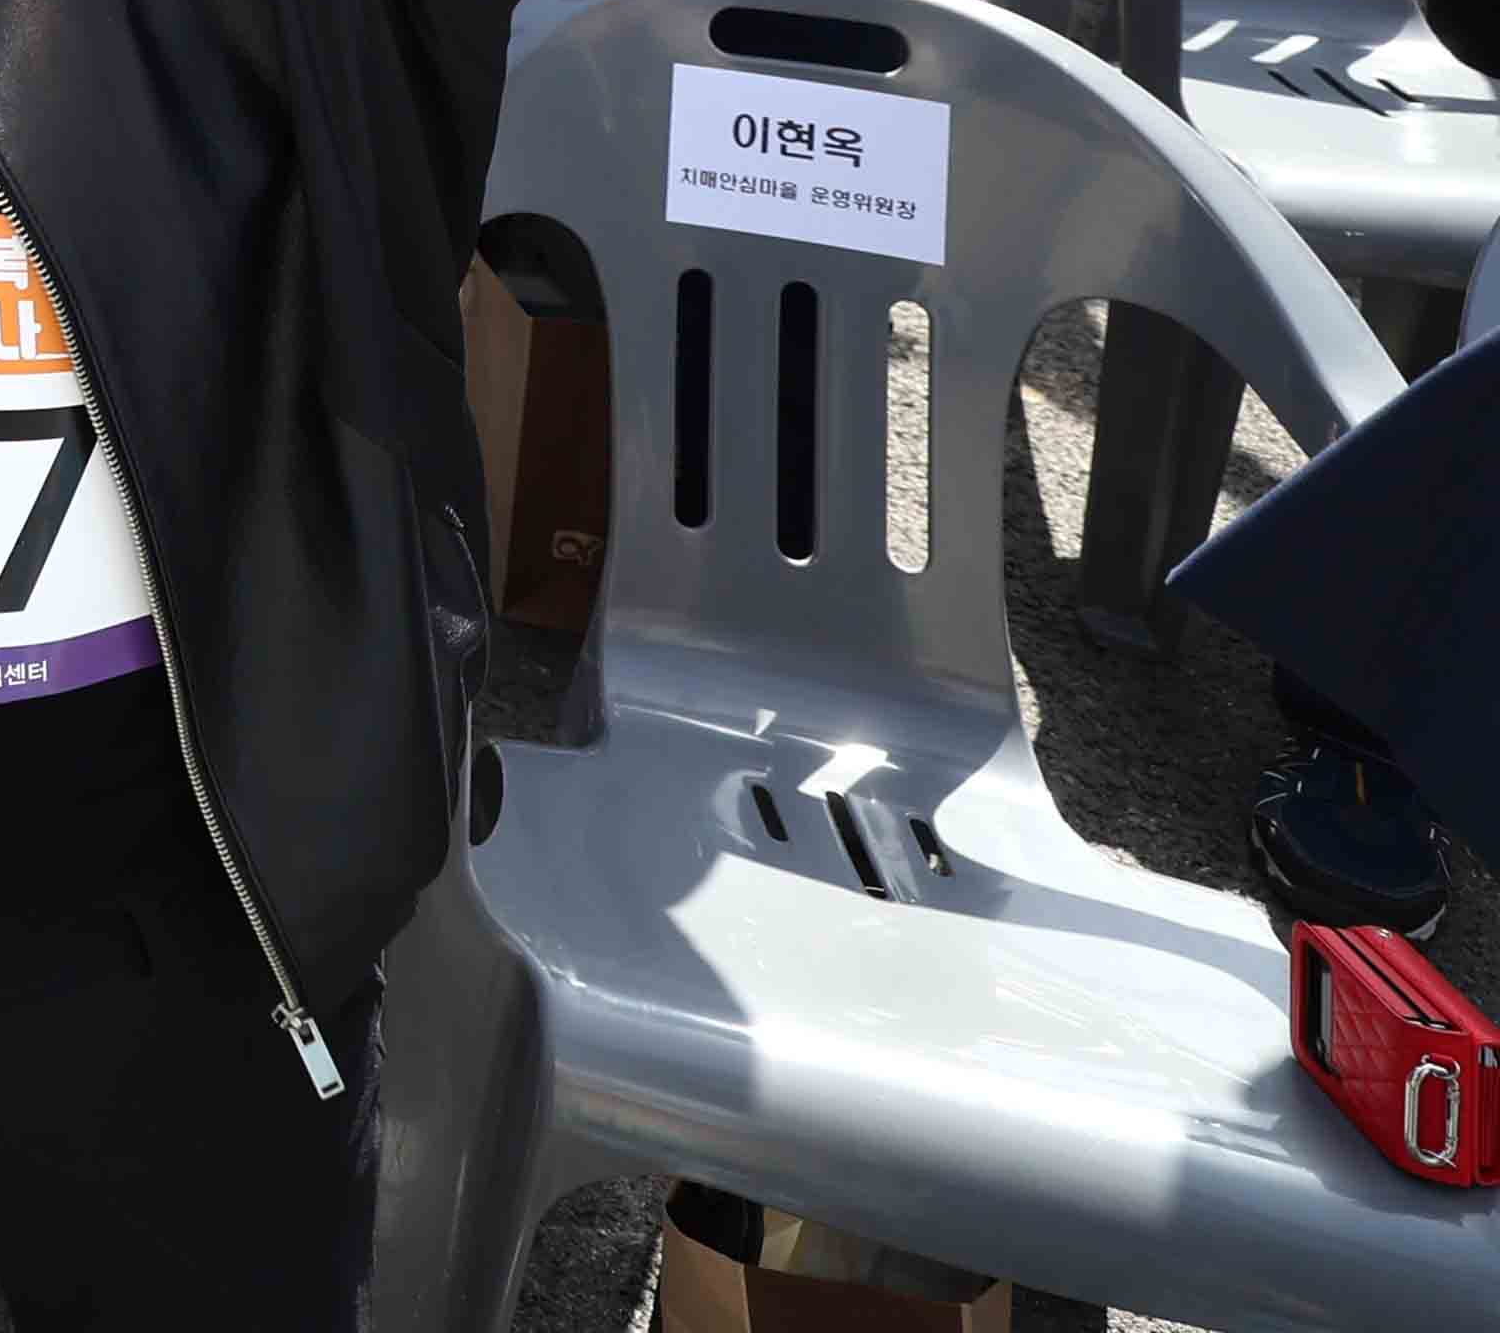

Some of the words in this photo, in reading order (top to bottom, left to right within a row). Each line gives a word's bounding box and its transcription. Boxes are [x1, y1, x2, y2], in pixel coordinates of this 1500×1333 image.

[732, 113, 863, 169] 이현옥
[680, 167, 798, 201] 치매안심마을
[811, 186, 917, 221] 운영위원장
